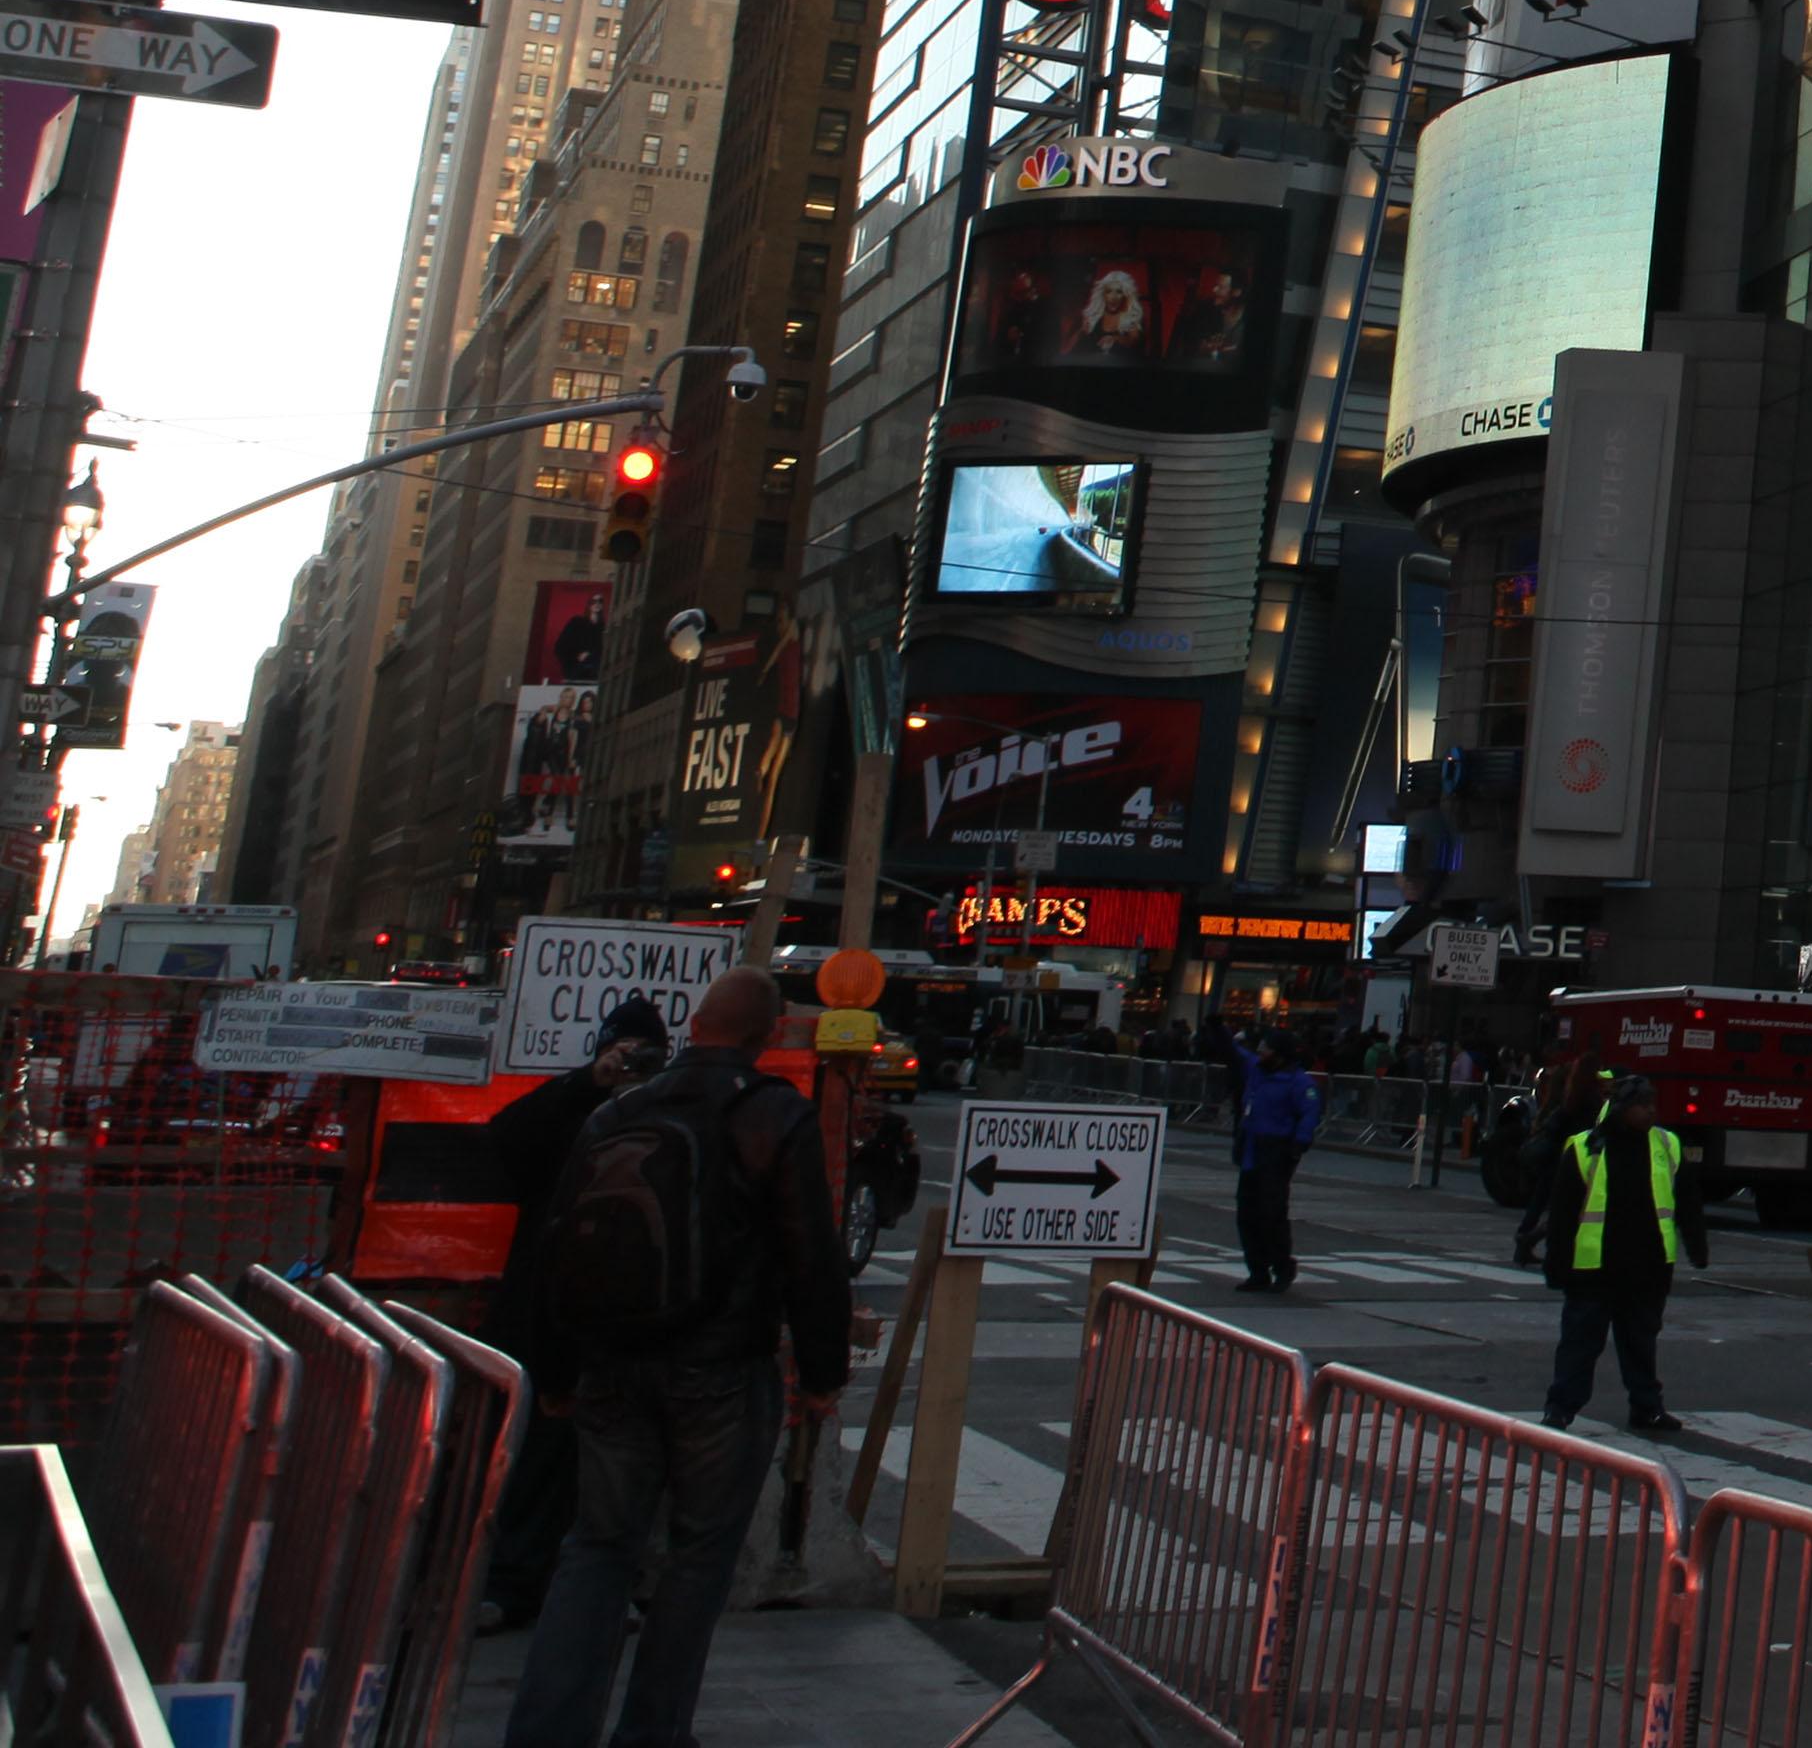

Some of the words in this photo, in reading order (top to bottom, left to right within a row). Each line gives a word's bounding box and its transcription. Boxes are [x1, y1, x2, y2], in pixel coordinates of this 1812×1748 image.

[5, 20, 95, 59] ONE
[139, 36, 229, 75] WAY
[1075, 146, 1171, 188] NBC
[1461, 403, 1533, 436] CHASE
[1099, 631, 1192, 651] AQUOS
[694, 679, 729, 721] LIVE
[683, 723, 751, 792] FAST
[1122, 786, 1154, 820] 4
[952, 829, 1019, 843] MONDAYS
[1121, 820, 1147, 828] NEW
[1150, 821, 1184, 830] YORK
[958, 897, 1087, 935] CHAMPS
[1426, 921, 1585, 959] CASE
[1448, 932, 1487, 945] BUSES
[537, 938, 715, 984] CROSSWALK
[1450, 952, 1481, 964] ONLY
[224, 988, 282, 1002] REPAIR
[411, 999, 476, 1015] SYSTEM
[215, 1029, 261, 1042] START
[524, 1030, 562, 1056] USE
[1618, 1016, 1673, 1045] Dunbar
[1724, 1088, 1803, 1110] Dunbar
[976, 1118, 1080, 1149] CROSSWALK
[1087, 1122, 1149, 1151] CLOSED
[983, 1207, 1016, 1239] USE
[1023, 1208, 1076, 1240] OTHER
[1084, 1210, 1120, 1242] SIDE
